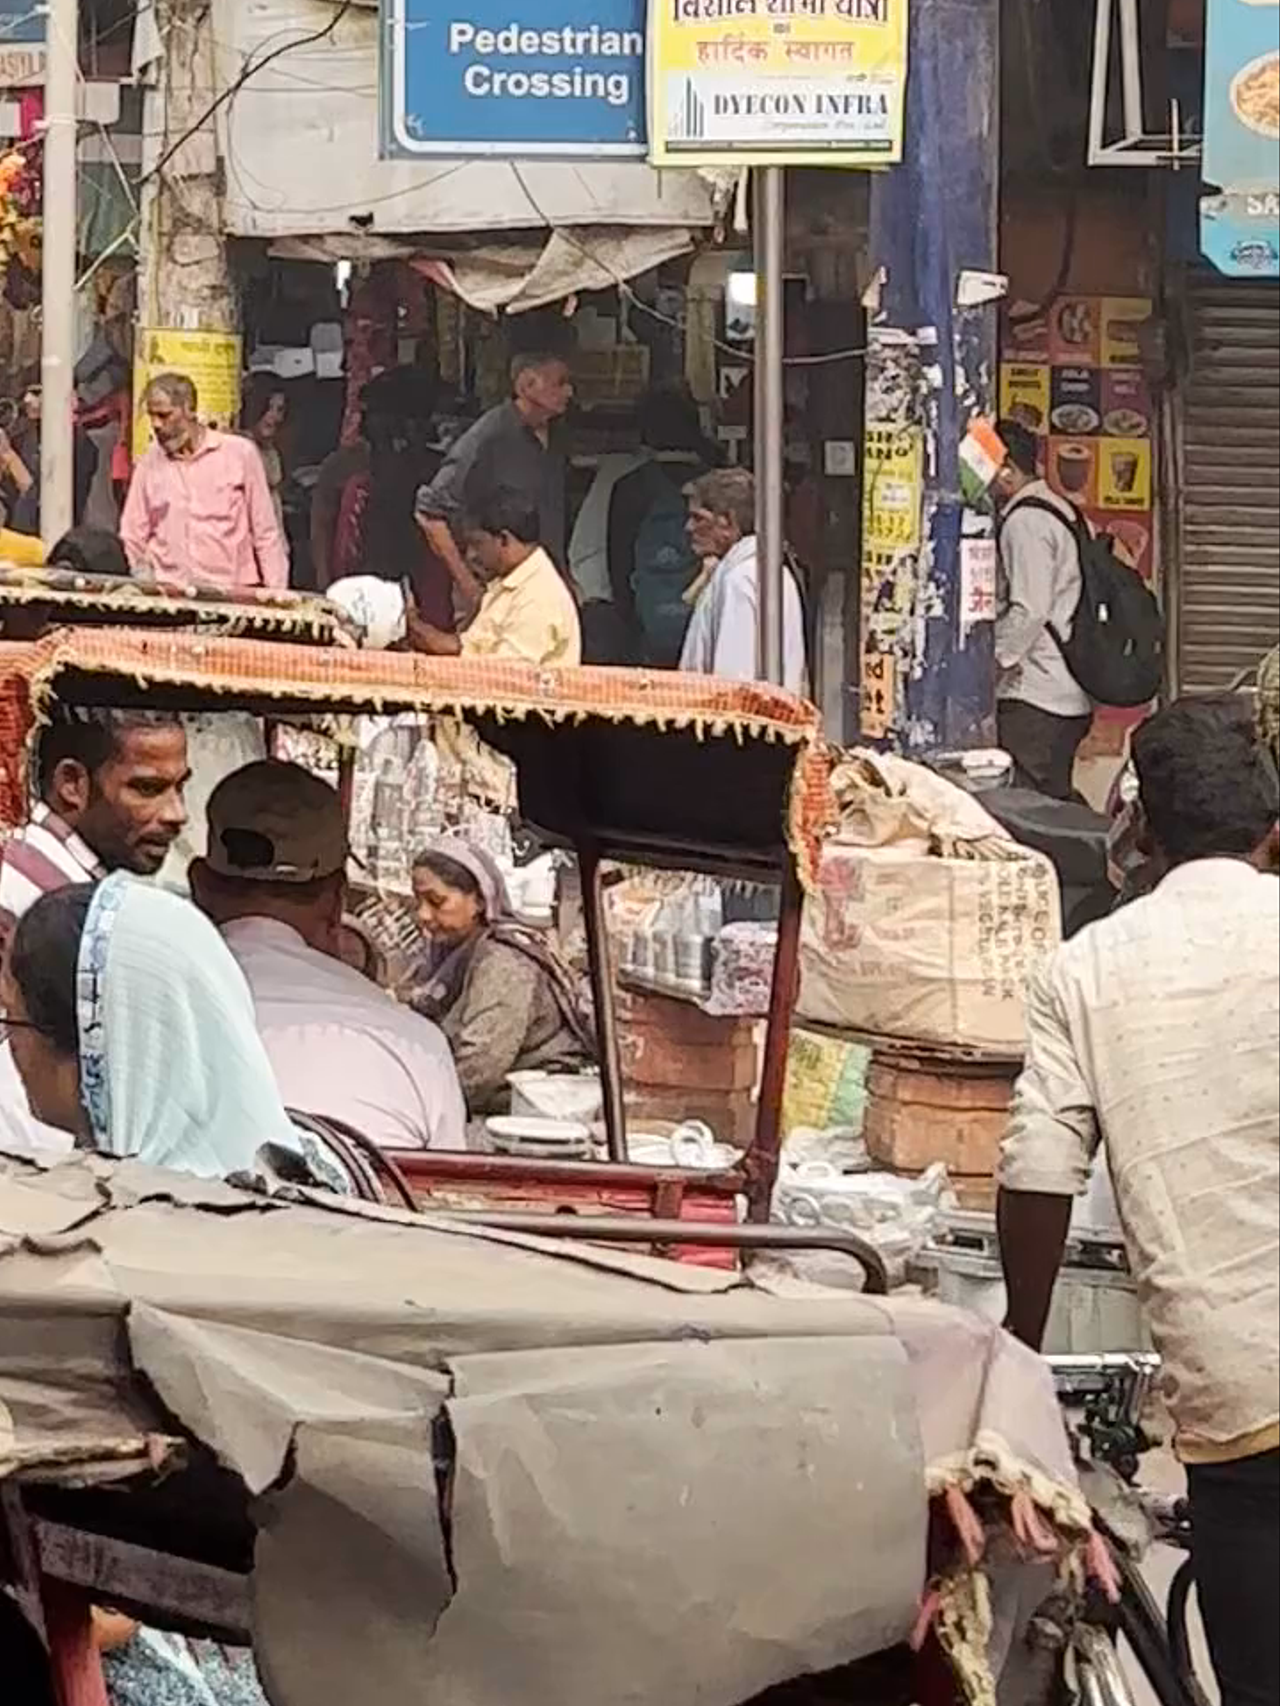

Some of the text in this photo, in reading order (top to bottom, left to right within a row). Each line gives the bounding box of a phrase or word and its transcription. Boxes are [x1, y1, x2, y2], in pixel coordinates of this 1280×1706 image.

[450, 21, 643, 57] Pedestrian
[696, 32, 855, 63] हार्दिक स्वागत
[464, 65, 630, 105] Crossing
[714, 92, 889, 115] DYECON INFRA
